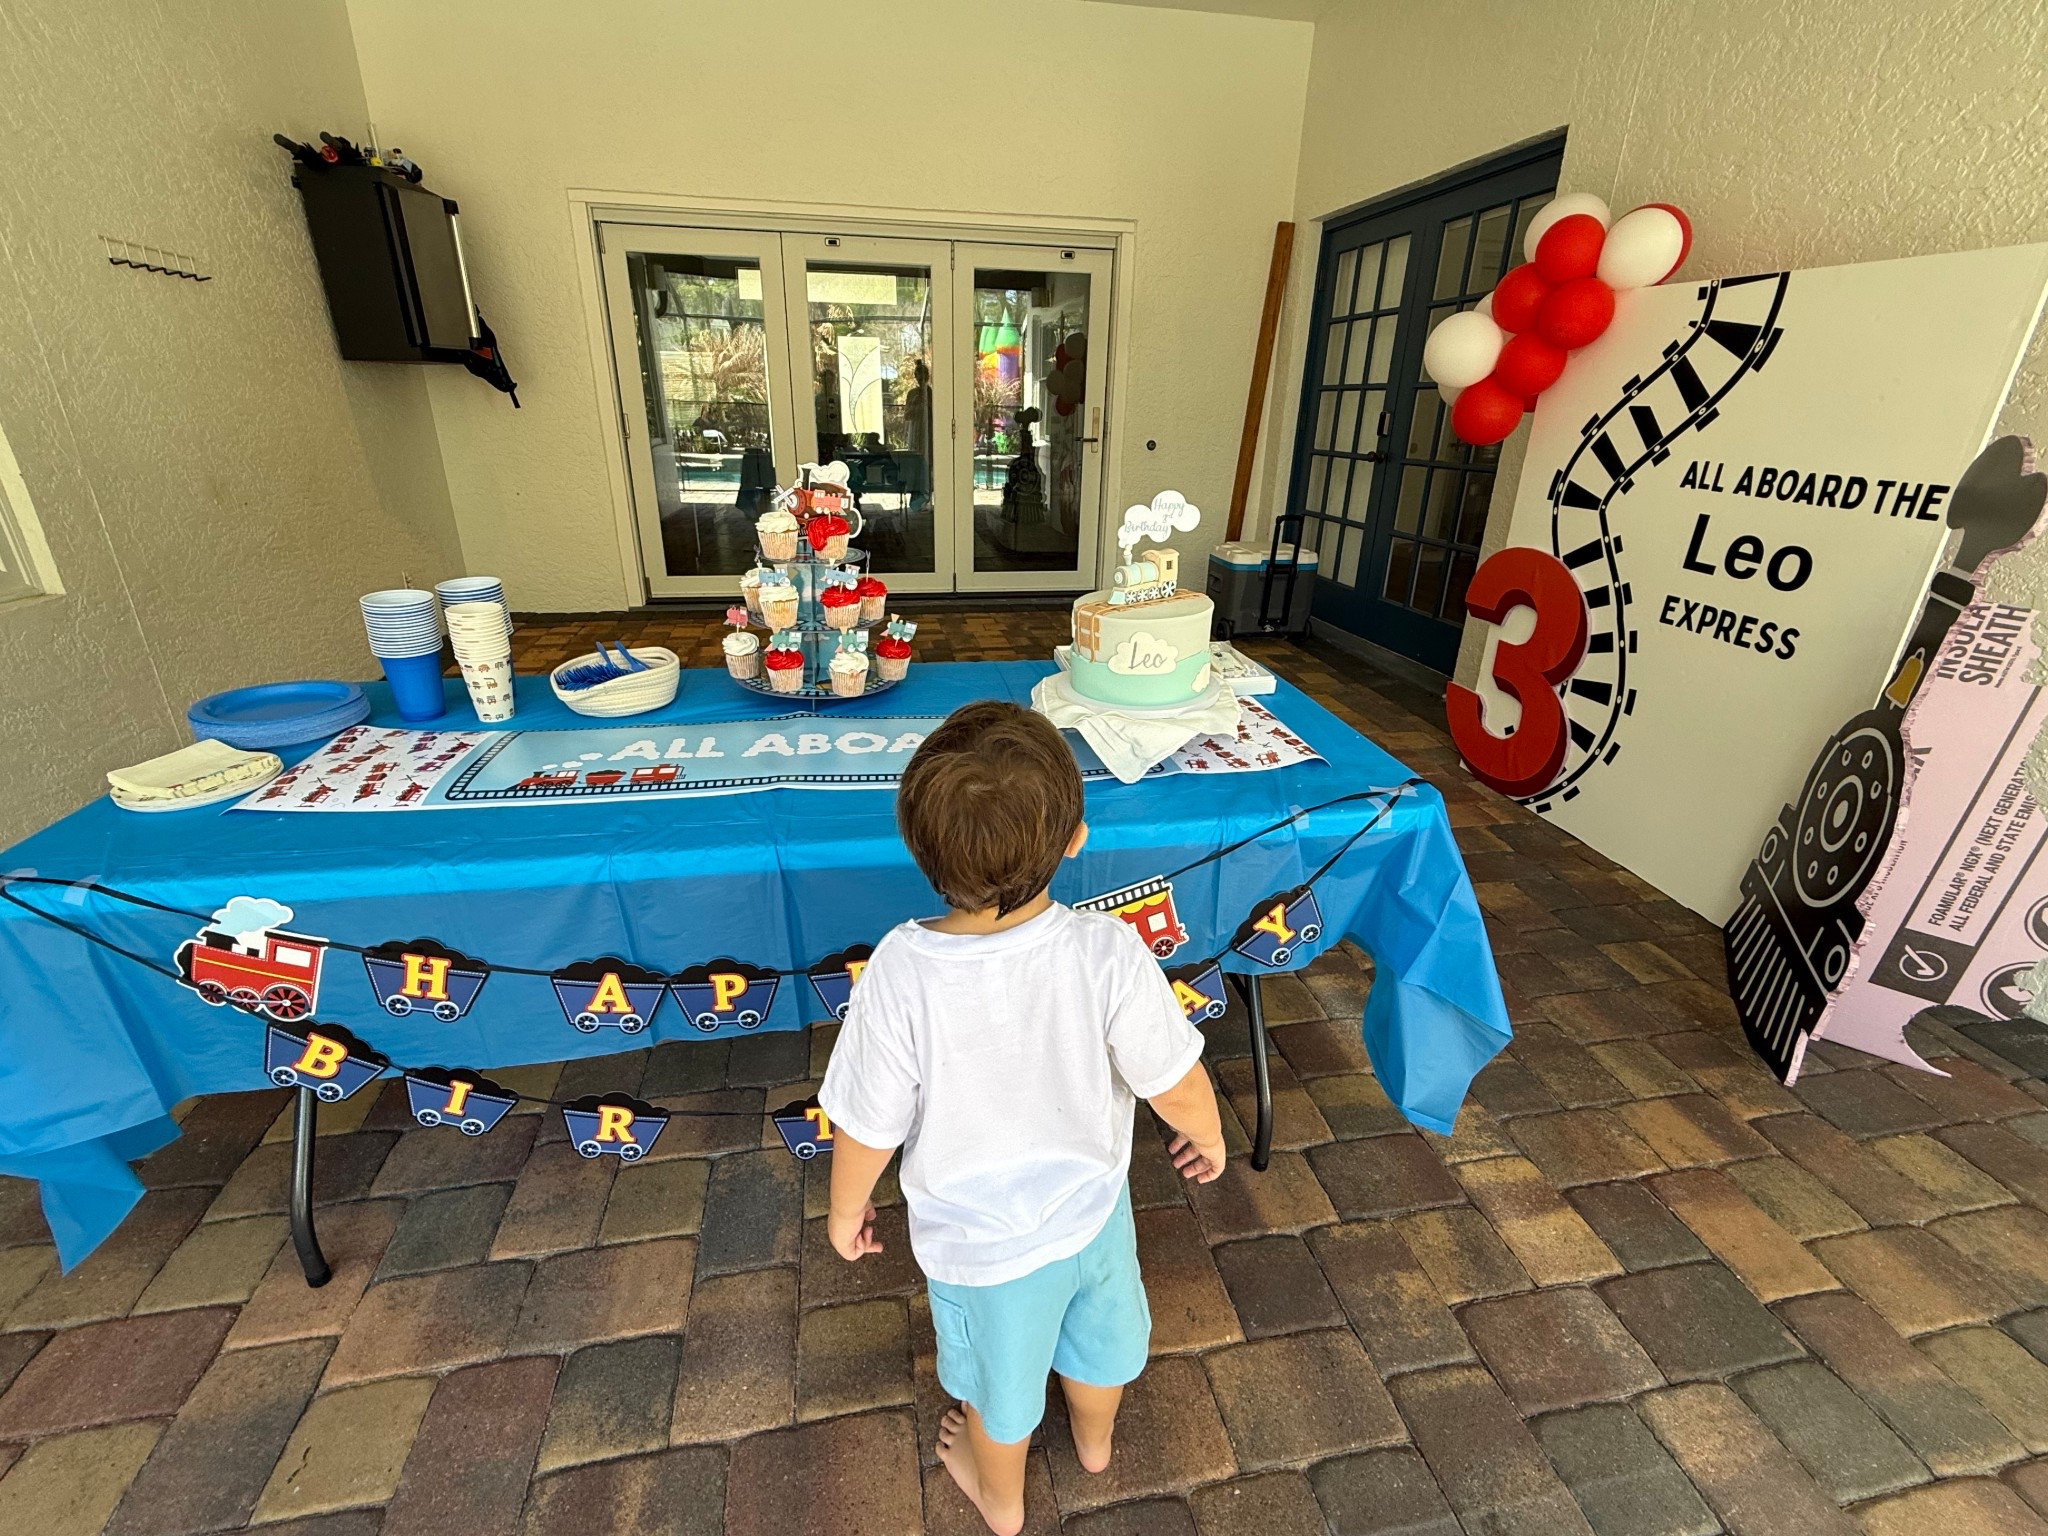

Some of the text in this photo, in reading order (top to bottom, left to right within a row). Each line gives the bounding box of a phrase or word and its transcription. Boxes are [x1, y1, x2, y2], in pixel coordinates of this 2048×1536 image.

[1153, 498, 1185, 518] Happy
[1680, 460, 1951, 522] ALL ABOARD THE
[1123, 520, 1169, 540] Birthday
[1683, 513, 1813, 592] Leo
[1128, 641, 1168, 670] Leo
[1659, 594, 1801, 661] EXPRESS
[1958, 603, 2032, 686] SHEATH
[1446, 546, 1592, 797] 3
[606, 735, 725, 762] ALL
[1976, 815, 2004, 847] (NEXT
[1949, 912, 1969, 933] ALL
[1964, 873, 1995, 915] FEDERAL
[1983, 852, 2007, 880] AND
[1995, 820, 2027, 853] STATE
